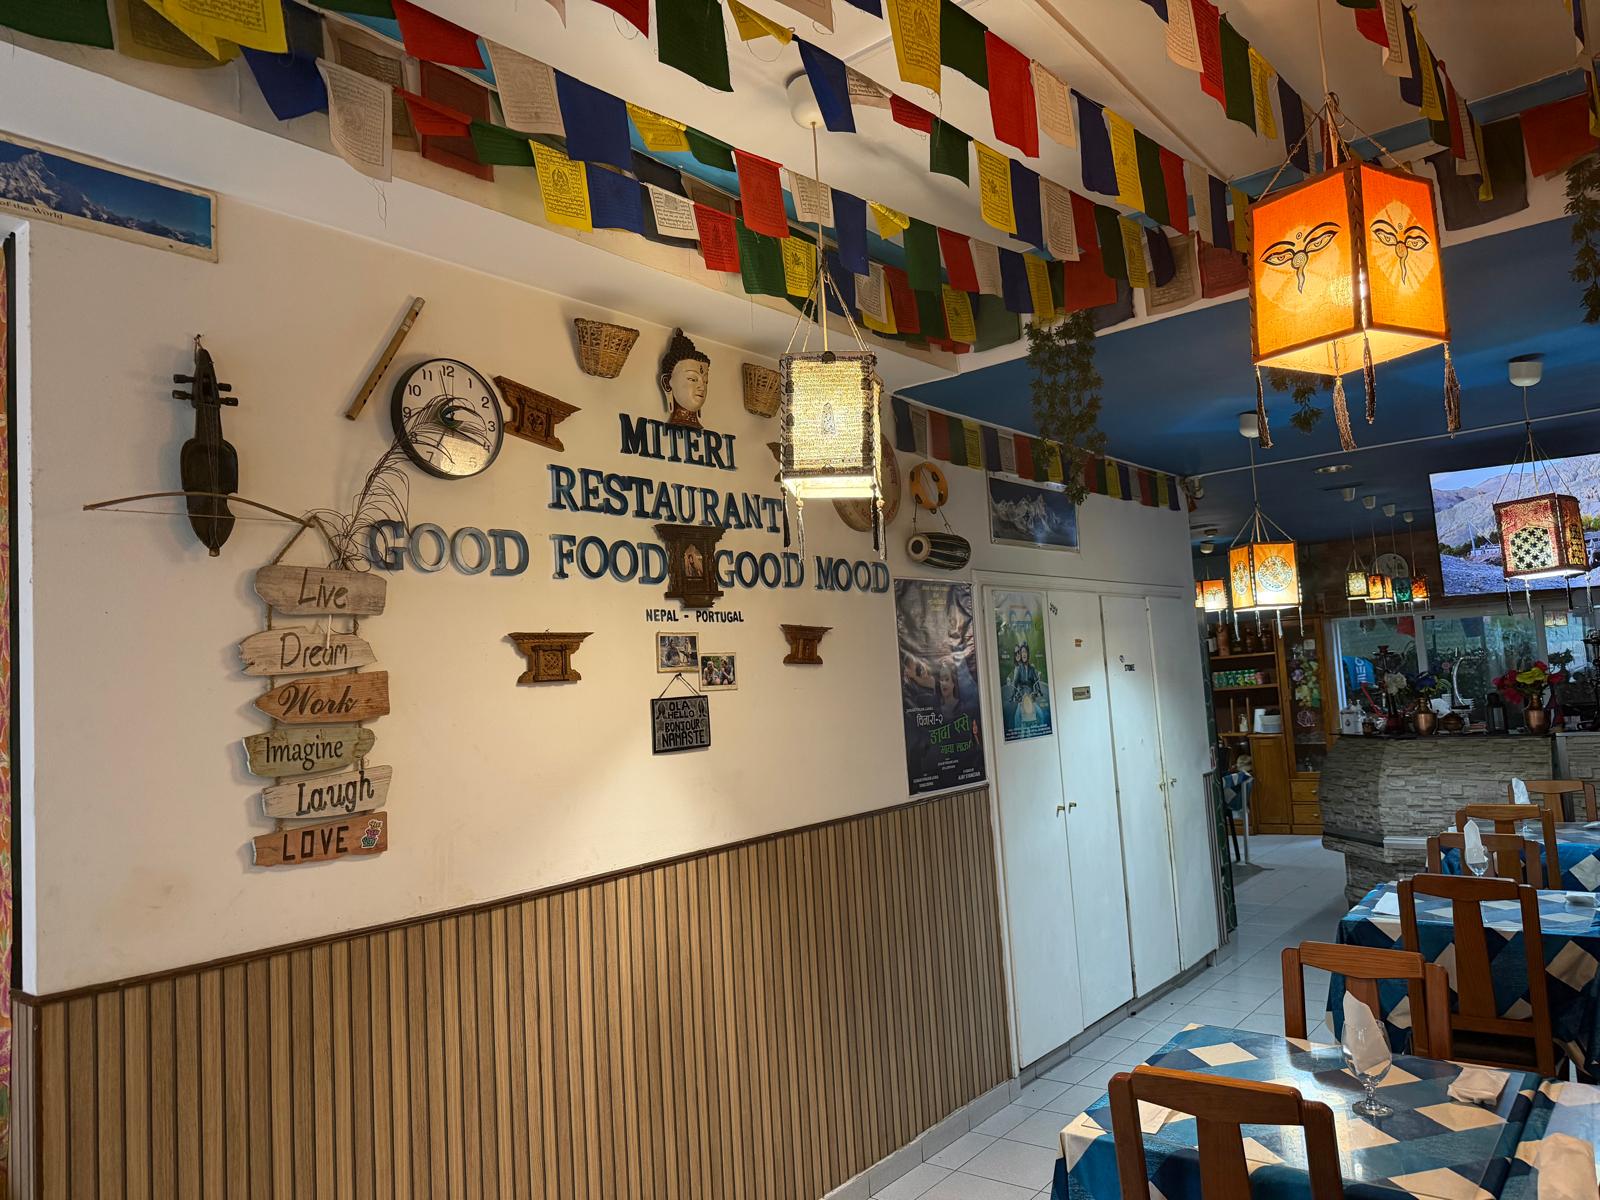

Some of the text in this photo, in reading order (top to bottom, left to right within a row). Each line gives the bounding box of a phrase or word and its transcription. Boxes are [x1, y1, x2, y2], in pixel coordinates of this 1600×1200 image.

[32, 206, 63, 220] World
[422, 368, 433, 382] 11
[442, 365, 455, 378] 12
[408, 384, 422, 397] 10
[481, 396, 490, 409] 2
[403, 406, 412, 419] 9
[488, 420, 496, 432] 3
[619, 413, 736, 471] MITERI
[426, 451, 434, 463] 7
[547, 463, 783, 533] RESTAURANT
[368, 519, 890, 593] GOOD FOOD GOOD MOOD
[298, 568, 349, 610] Live
[646, 609, 679, 622] NEPAL
[696, 610, 744, 623] PORTUGAL
[279, 632, 348, 671] Dream
[277, 684, 358, 718] Work
[667, 710, 695, 720] HELLO
[664, 719, 701, 734] BONJOUR
[662, 729, 705, 748] NAMASTE
[263, 736, 344, 771] Imagine
[295, 770, 375, 817] Laugh
[282, 825, 350, 862] LOVE
